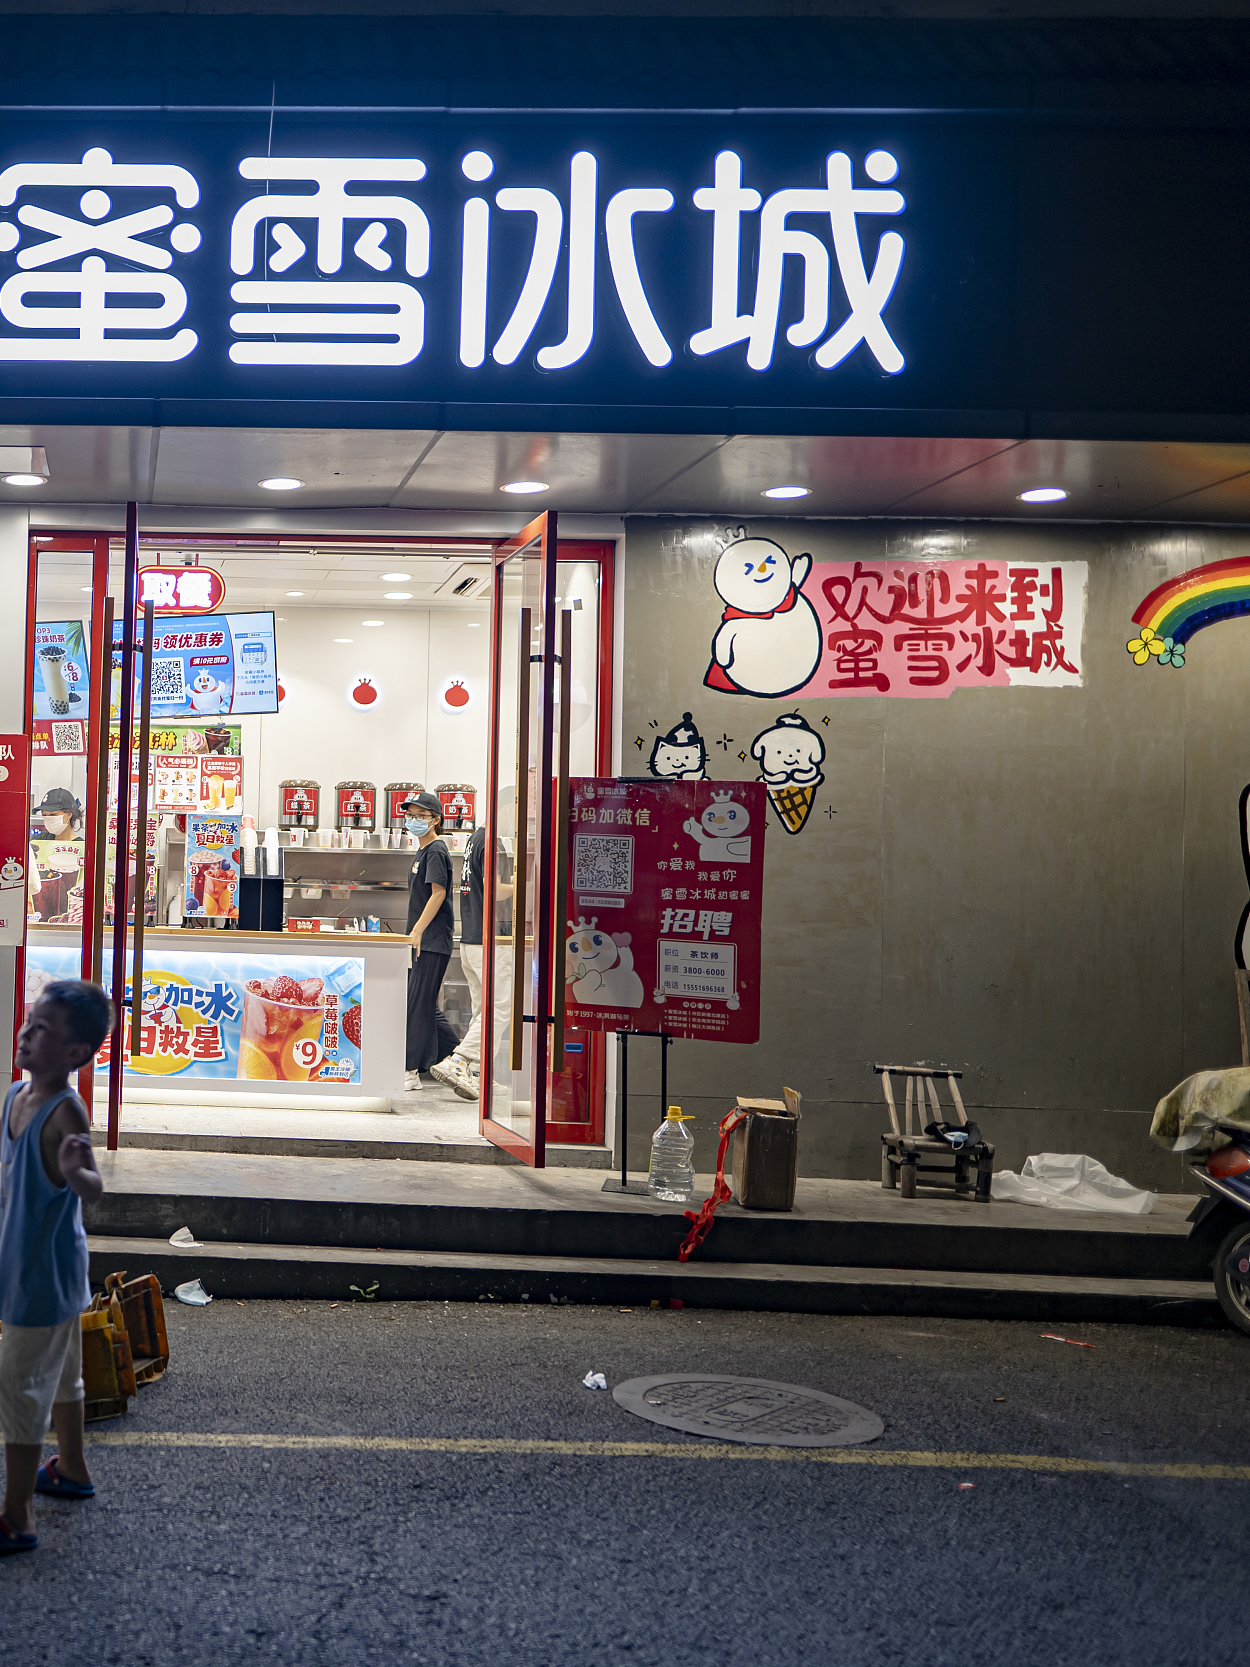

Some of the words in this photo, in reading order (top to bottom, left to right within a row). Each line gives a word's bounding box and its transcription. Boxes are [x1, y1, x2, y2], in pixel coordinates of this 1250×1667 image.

[141, 572, 212, 607] 取餐
[826, 561, 1064, 627] 欢迎来到
[163, 631, 224, 649] 领优惠券
[825, 620, 1080, 692] 蜜雪冰城
[192, 823, 209, 833] 果茶
[217, 822, 239, 833] 加冰
[195, 832, 235, 847] 夏日救星
[657, 857, 696, 871] 你爱我
[697, 869, 737, 882] 我爱你
[661, 887, 750, 901] 蜜雪冰城甜蜜蜜
[660, 908, 733, 941] 招聘
[664, 948, 679, 957] 职位
[689, 950, 719, 960] 茶饮师
[664, 964, 679, 974] 薪资
[683, 966, 726, 977] 3800-6000
[664, 980, 679, 990] 电话
[165, 981, 238, 1021] 加冰
[325, 994, 339, 1050] 草莓啵啵
